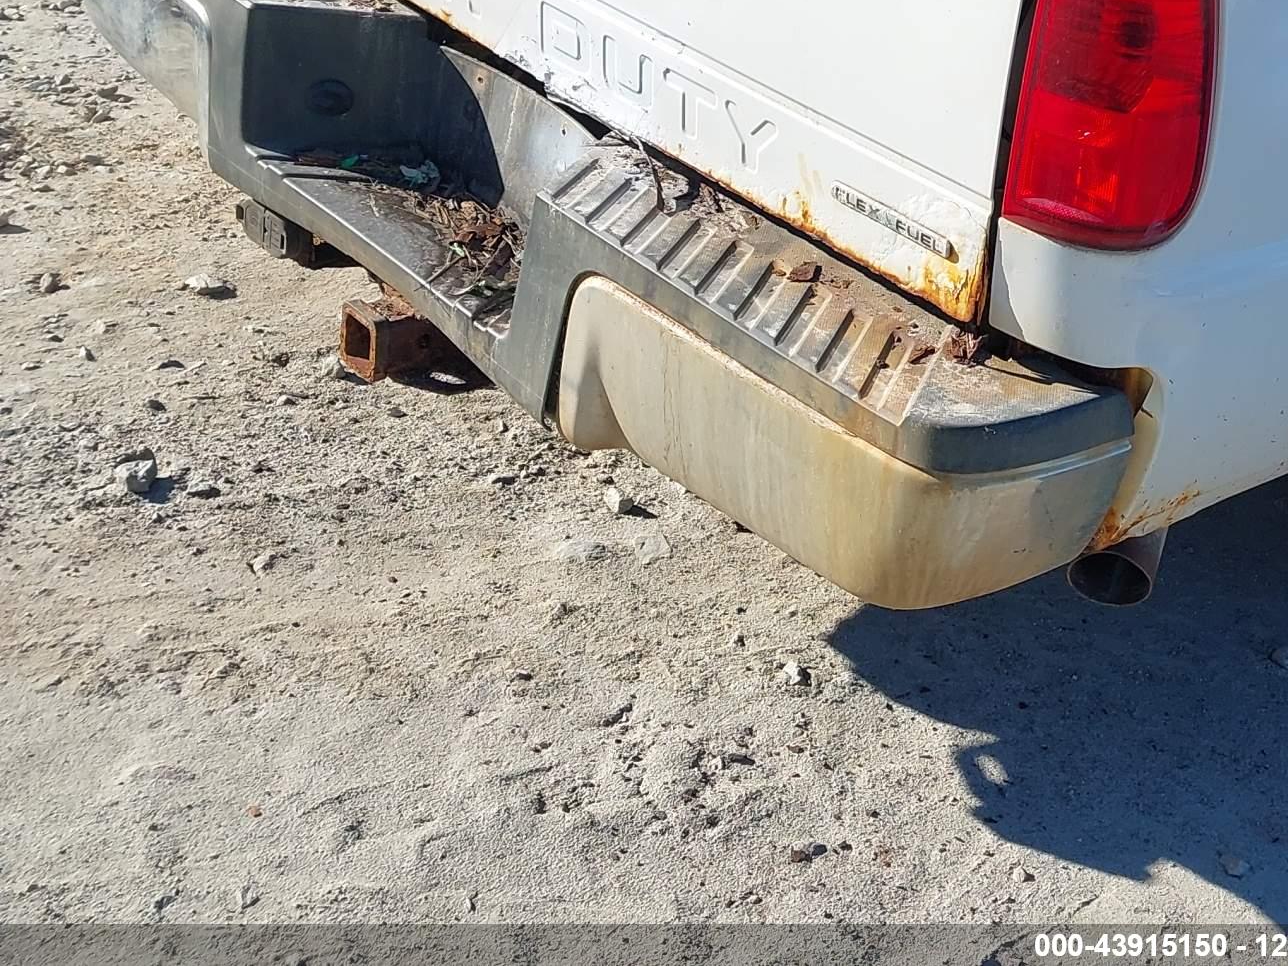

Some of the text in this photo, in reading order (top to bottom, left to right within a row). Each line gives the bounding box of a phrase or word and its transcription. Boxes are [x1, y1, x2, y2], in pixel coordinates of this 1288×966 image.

[540, 0, 779, 175] DUTY
[834, 186, 943, 255] FLEX FUEL
